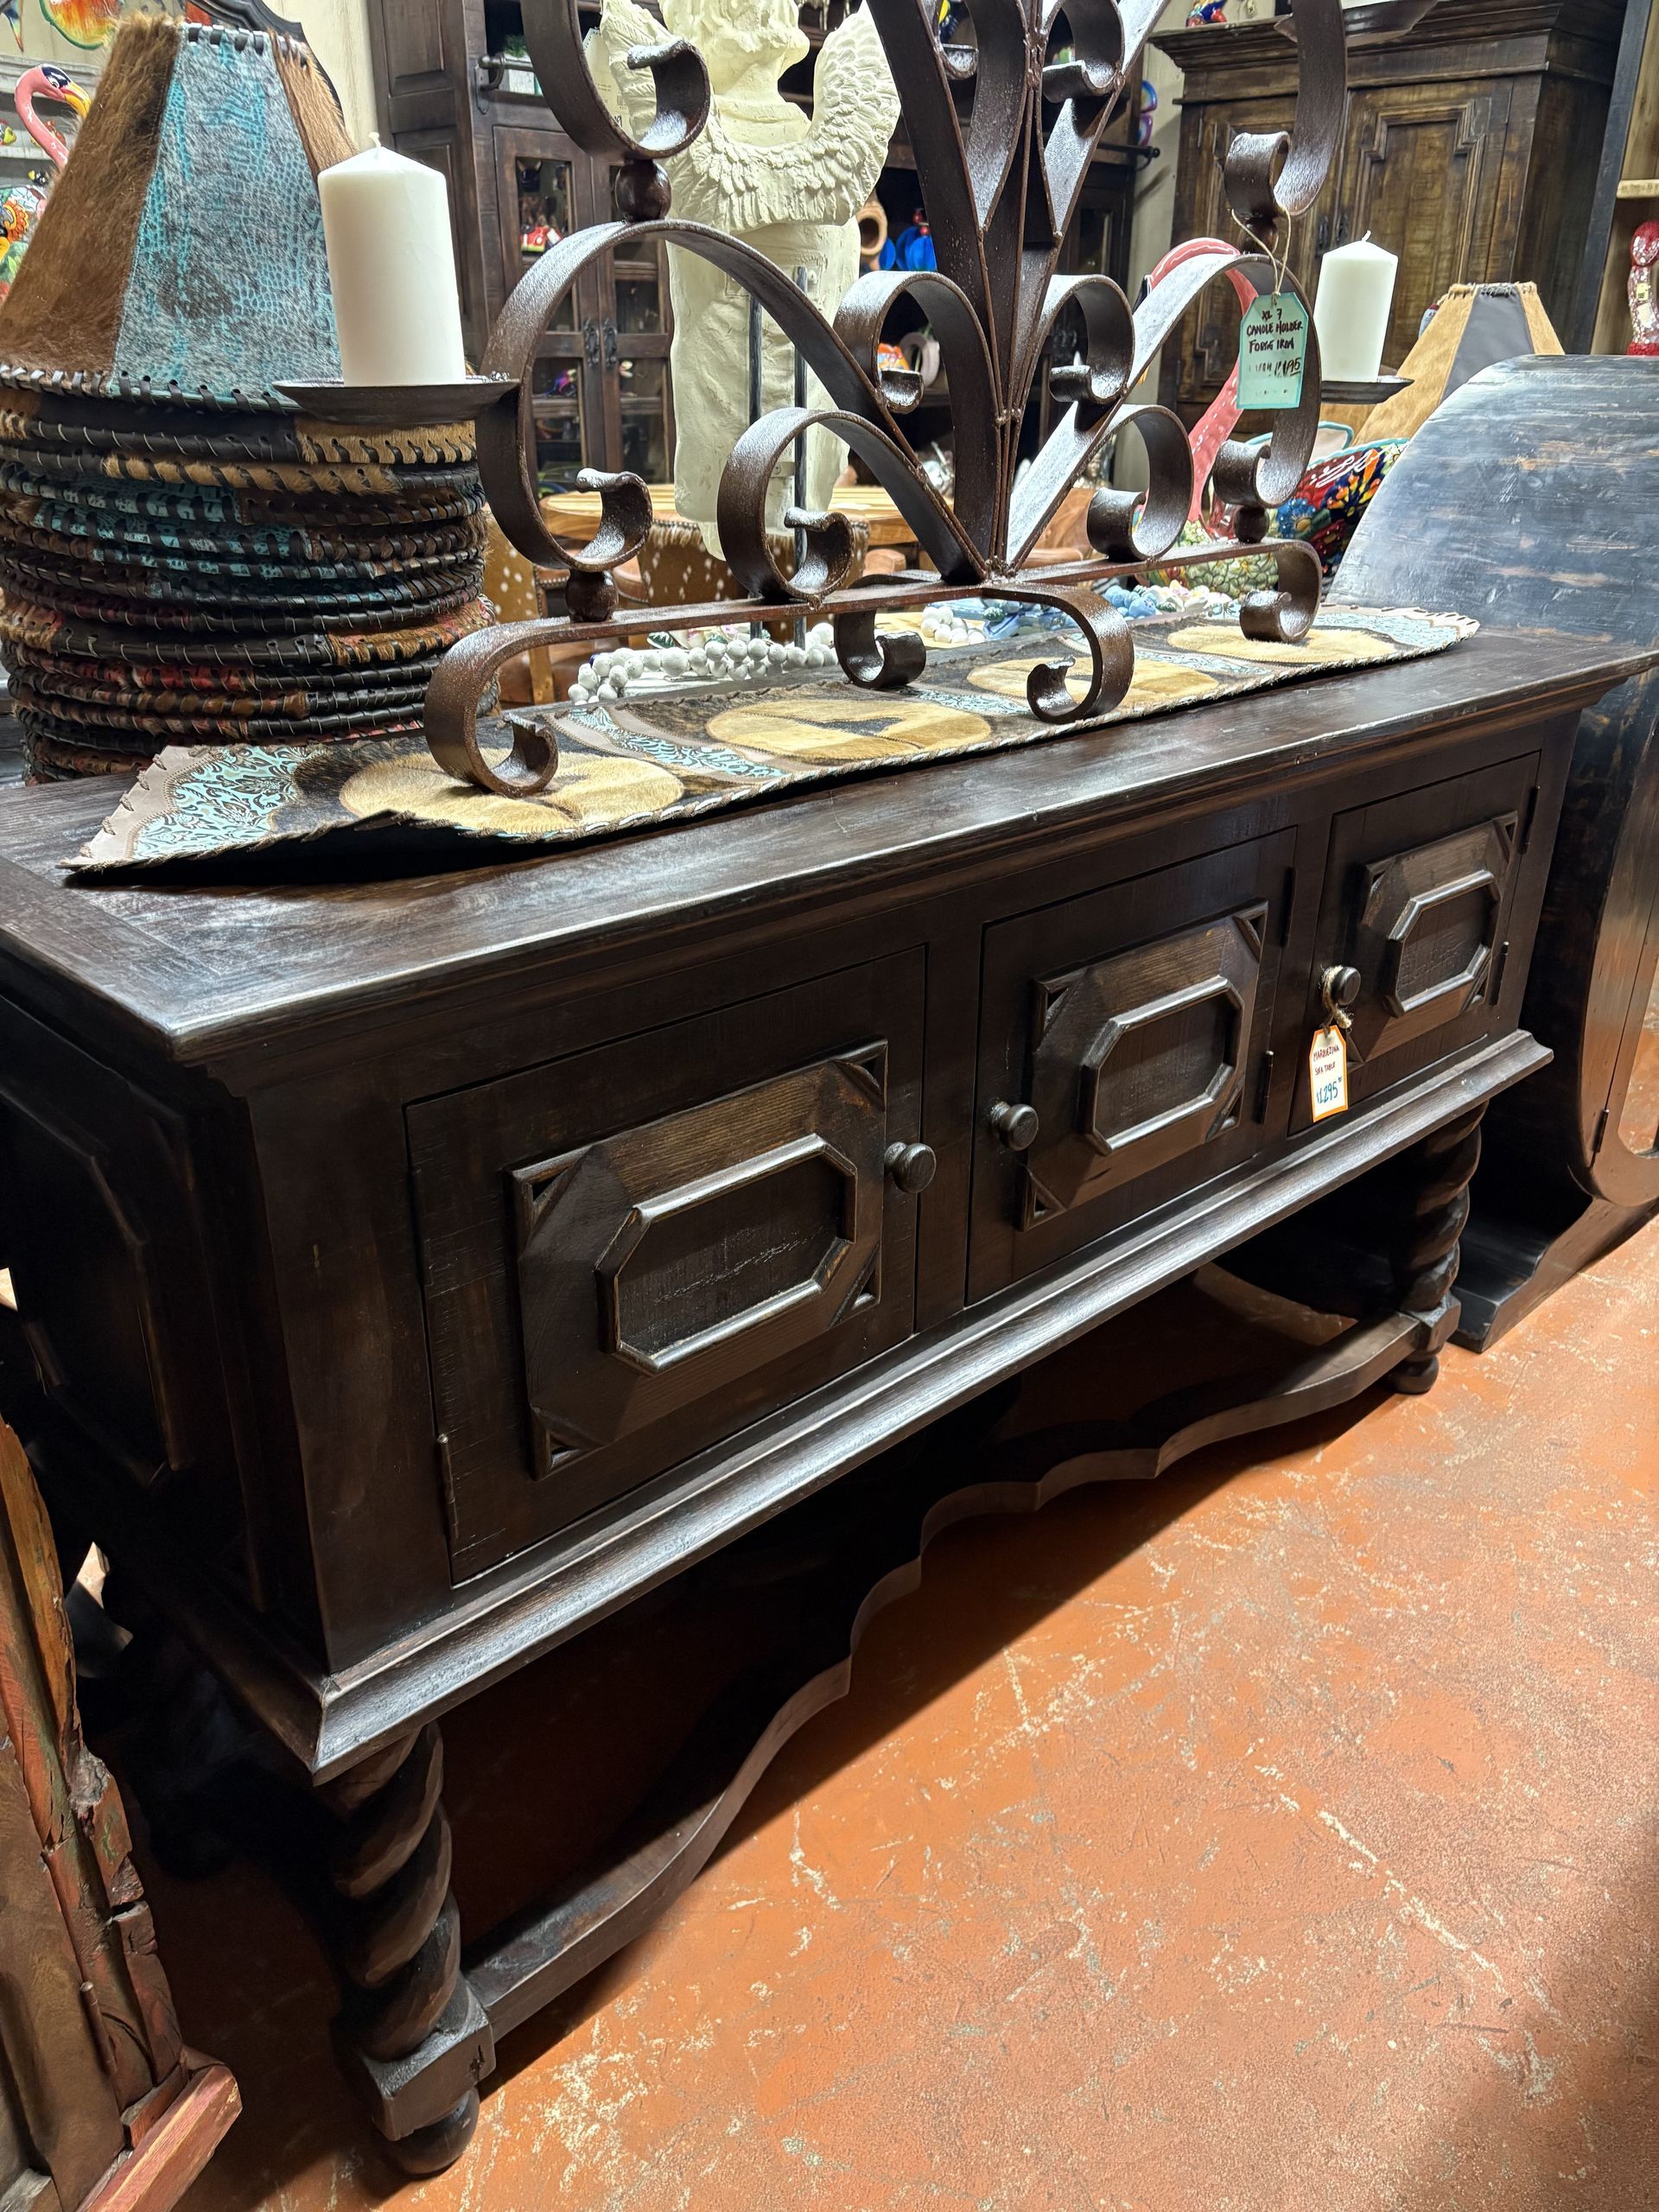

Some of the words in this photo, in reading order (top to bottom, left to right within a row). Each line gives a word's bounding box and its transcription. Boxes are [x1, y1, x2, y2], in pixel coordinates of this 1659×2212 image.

[1246, 322, 1274, 336] CANDLE
[1275, 321, 1303, 335] HOLDER
[1276, 337, 1294, 350] IRON
